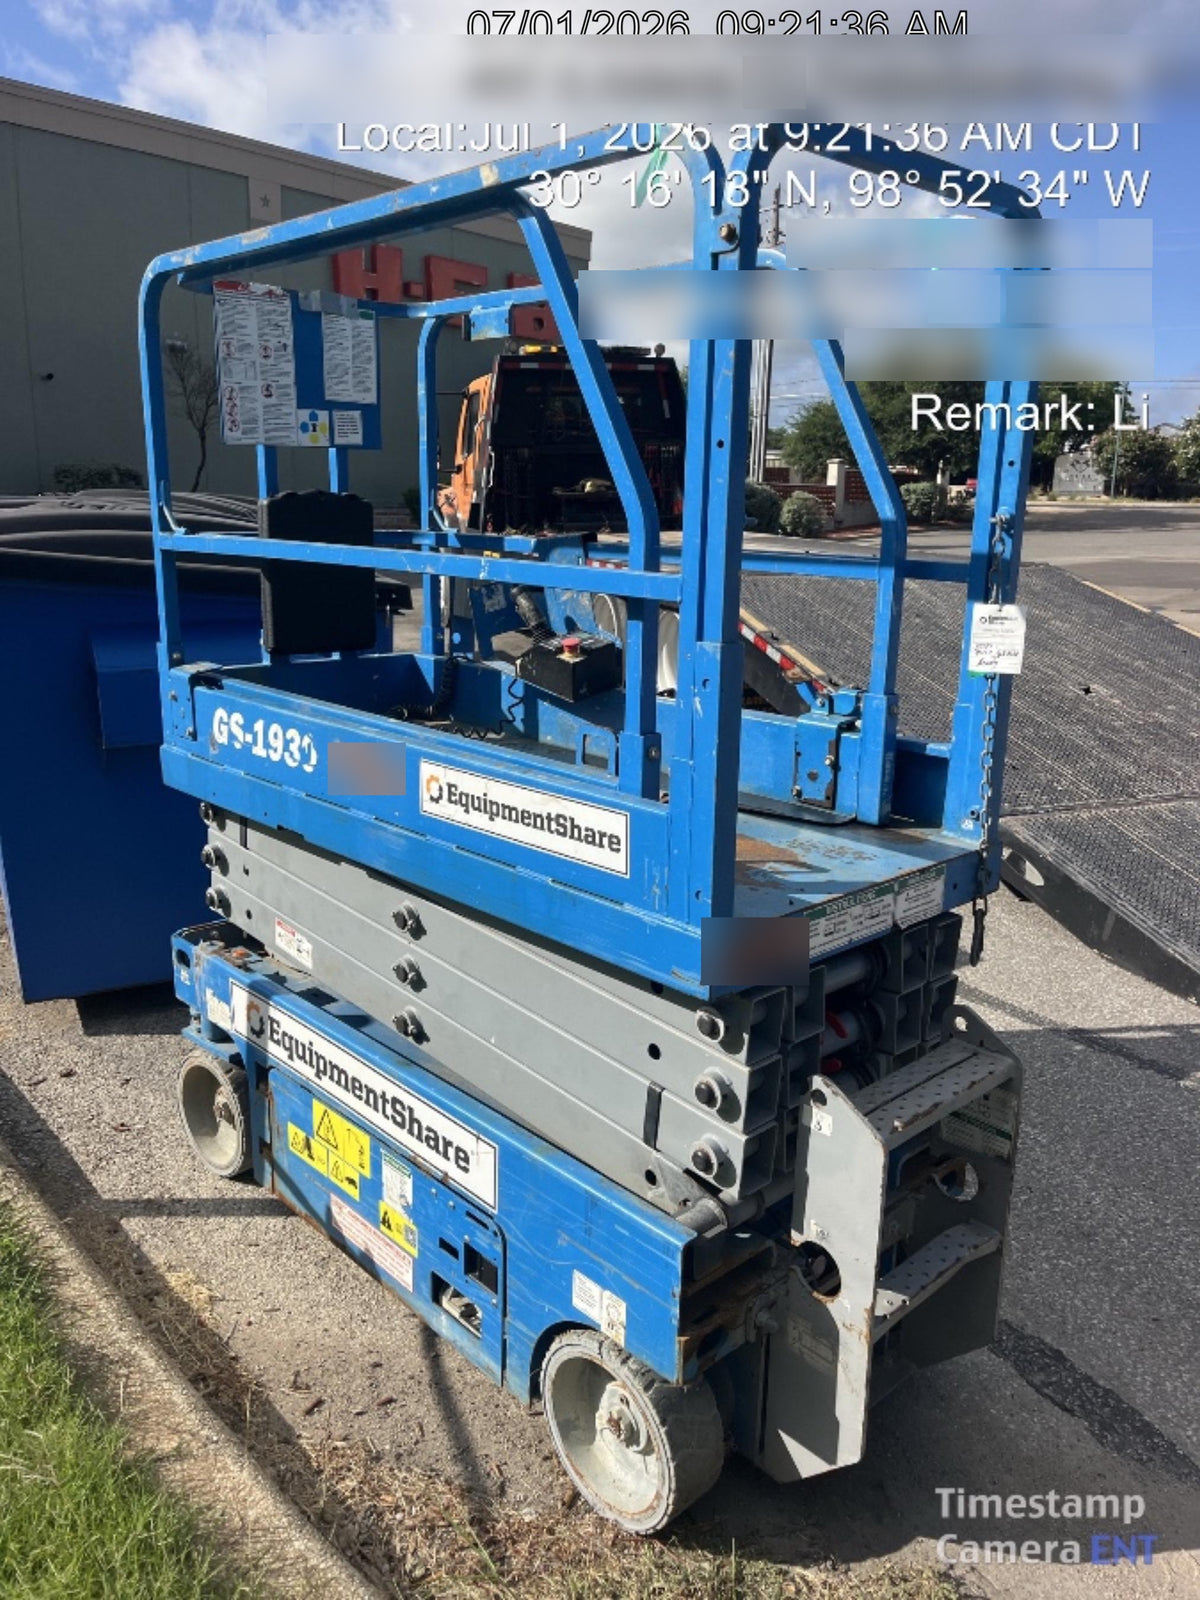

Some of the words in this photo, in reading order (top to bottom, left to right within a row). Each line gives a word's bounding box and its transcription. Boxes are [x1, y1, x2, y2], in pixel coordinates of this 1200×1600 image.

[213, 707, 318, 773] GS-1930
[446, 782, 621, 854] EquipmentShare
[267, 1015, 470, 1174] EquipmentShare
